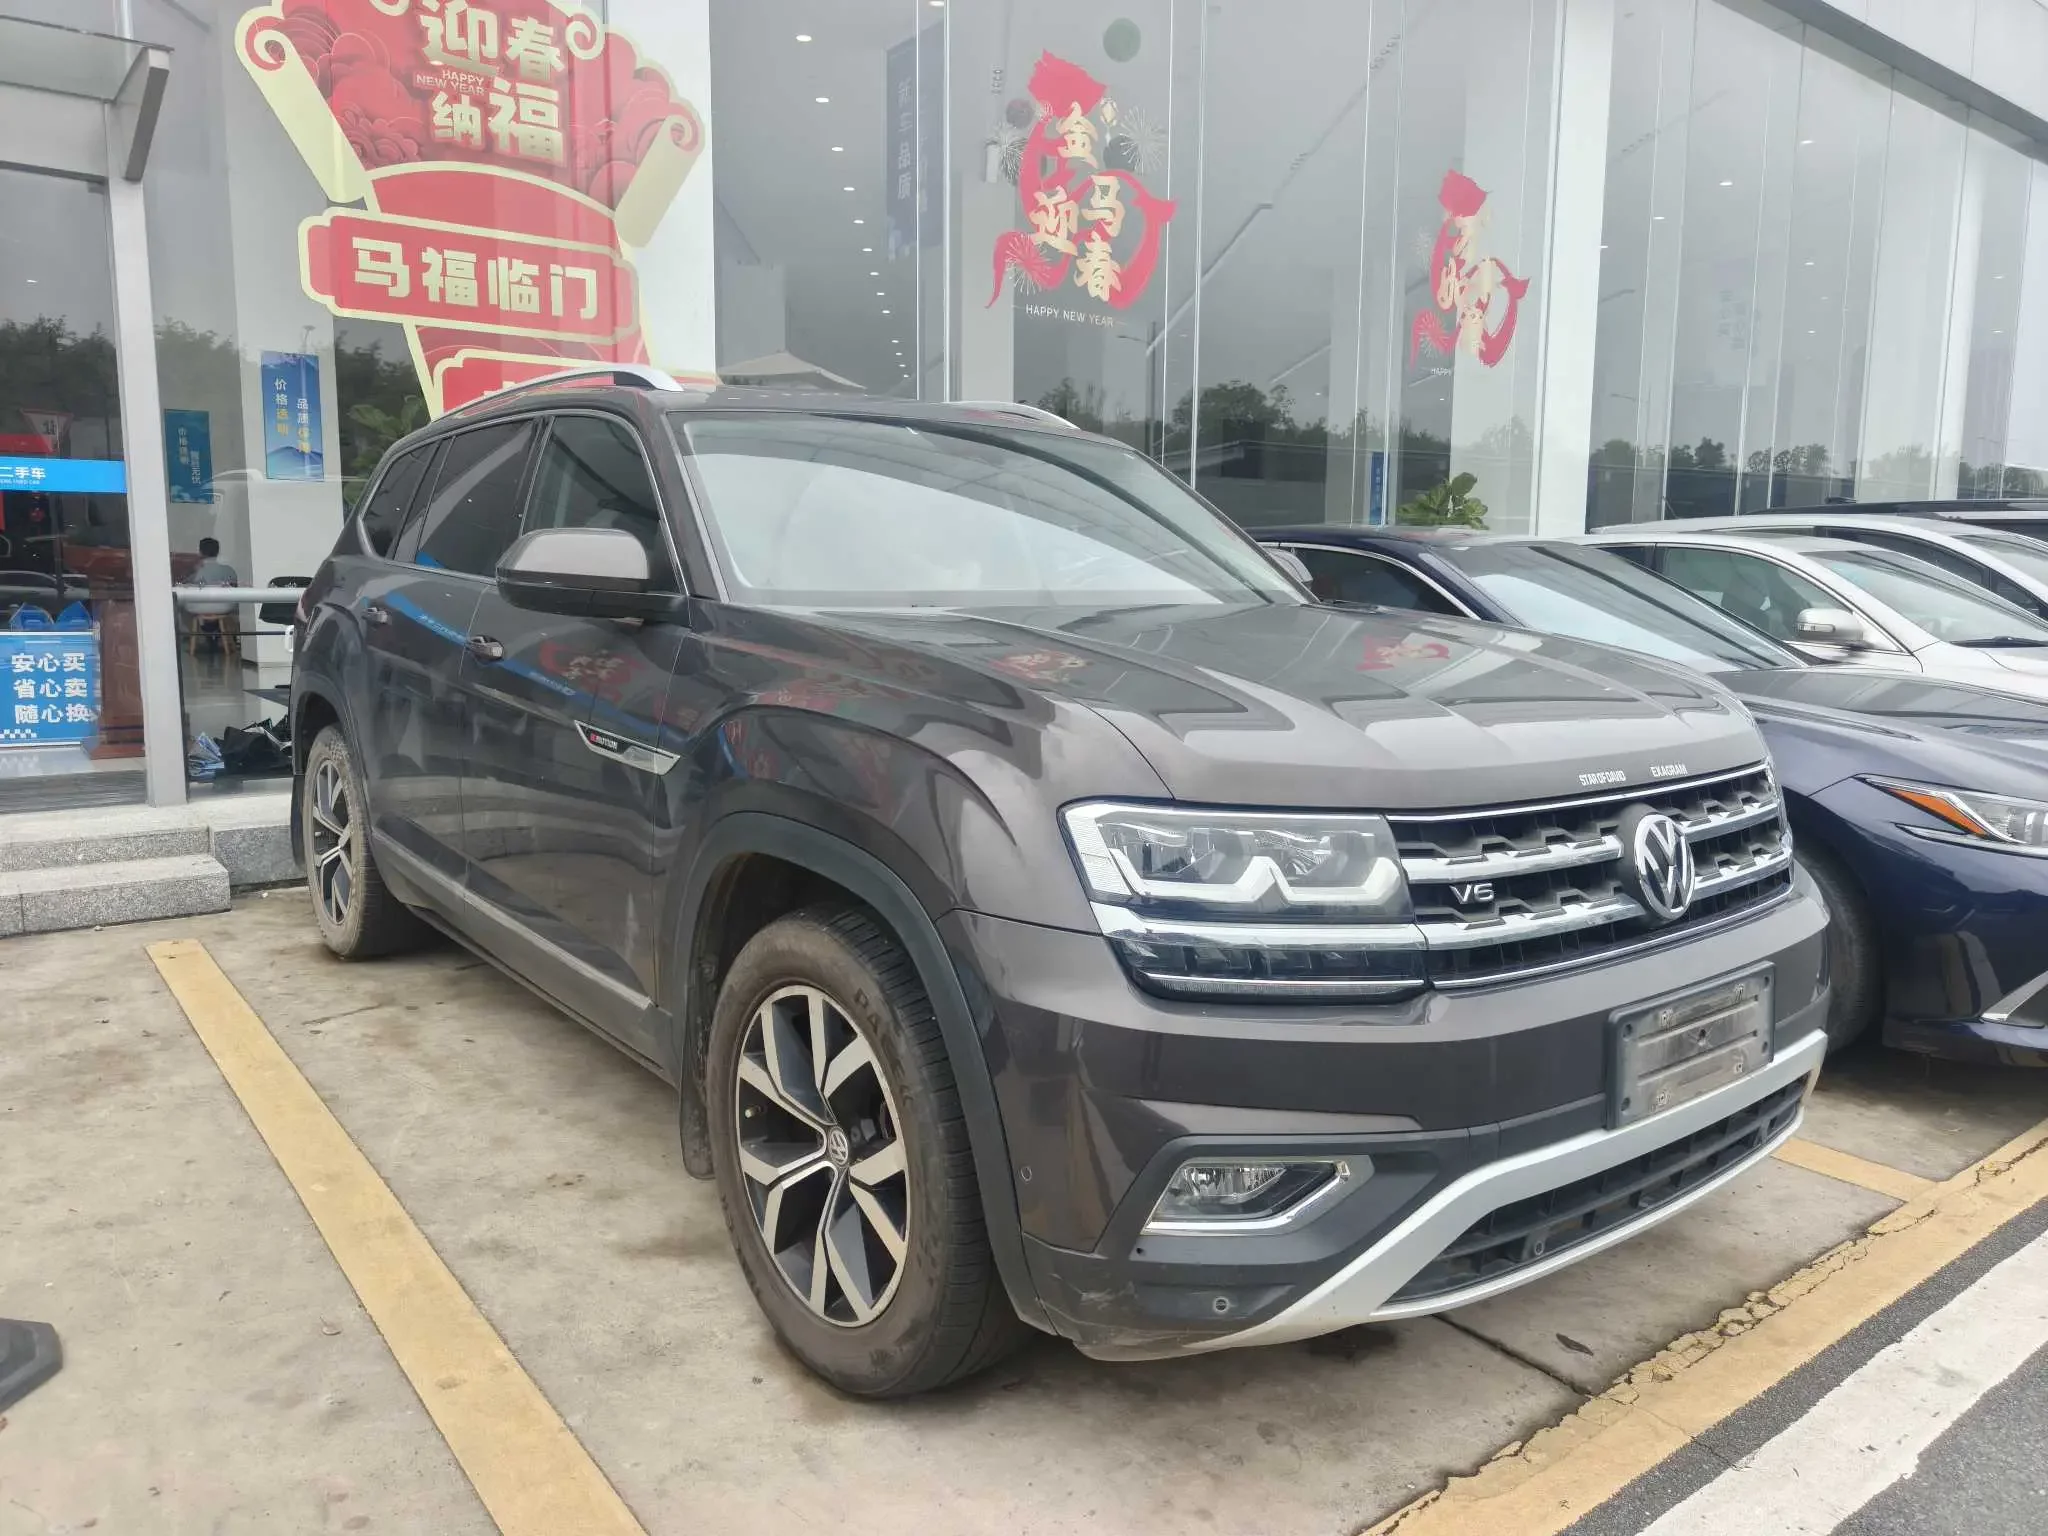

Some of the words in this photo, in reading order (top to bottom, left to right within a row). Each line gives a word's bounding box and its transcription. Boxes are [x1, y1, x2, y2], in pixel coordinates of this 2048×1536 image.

[415, 73, 446, 89] NEW
[450, 80, 485, 96] YEAR
[441, 69, 485, 86] HAPPY
[351, 236, 599, 320] 马福临门
[1025, 303, 1059, 318] HAPPY
[1062, 310, 1086, 323] NEW
[1089, 313, 1114, 327] YEAR
[11, 652, 87, 673] 安心买
[13, 678, 89, 699] 省心卖
[14, 704, 92, 724] 随心换
[1448, 882, 1495, 905] V6
